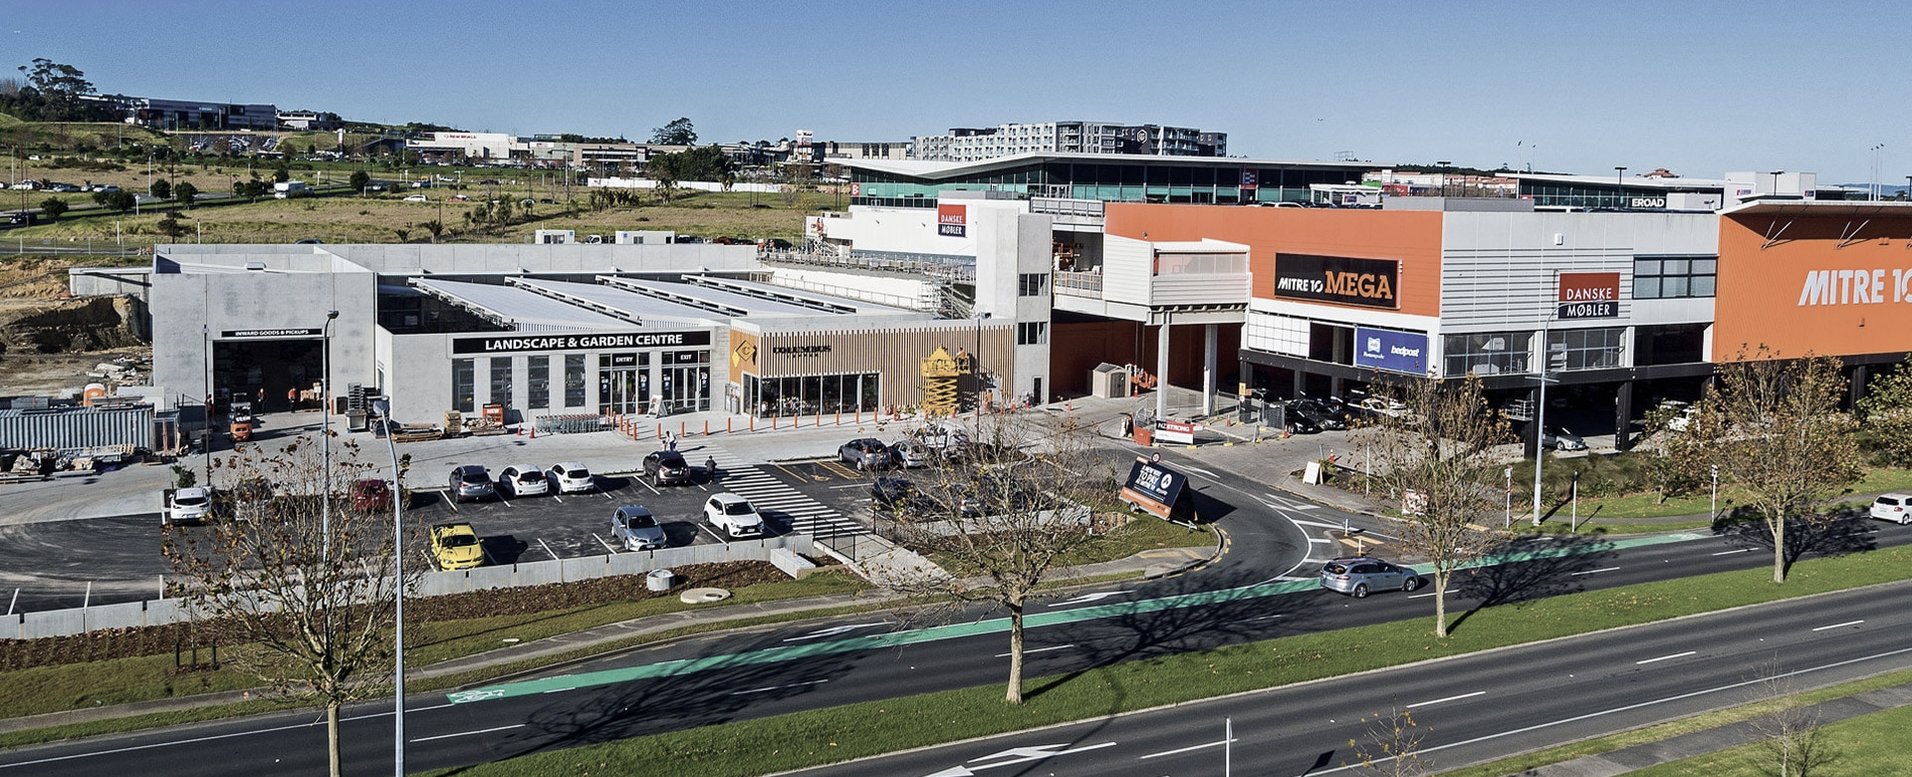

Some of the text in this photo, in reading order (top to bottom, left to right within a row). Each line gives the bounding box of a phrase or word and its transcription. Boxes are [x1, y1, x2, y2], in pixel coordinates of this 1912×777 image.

[1631, 198, 1665, 208] EROAD
[940, 214, 963, 224] DANSKE
[1277, 270, 1393, 300] MITRE 10 MEGA
[1797, 269, 1886, 306] MITRE
[1566, 287, 1612, 300] DANSKE
[1566, 303, 1610, 317] MØBLER
[485, 334, 684, 351] LANDSCAPE & GARDEN CENTRE
[1390, 345, 1420, 357] bedpost
[1138, 470, 1160, 485] TO PAY
